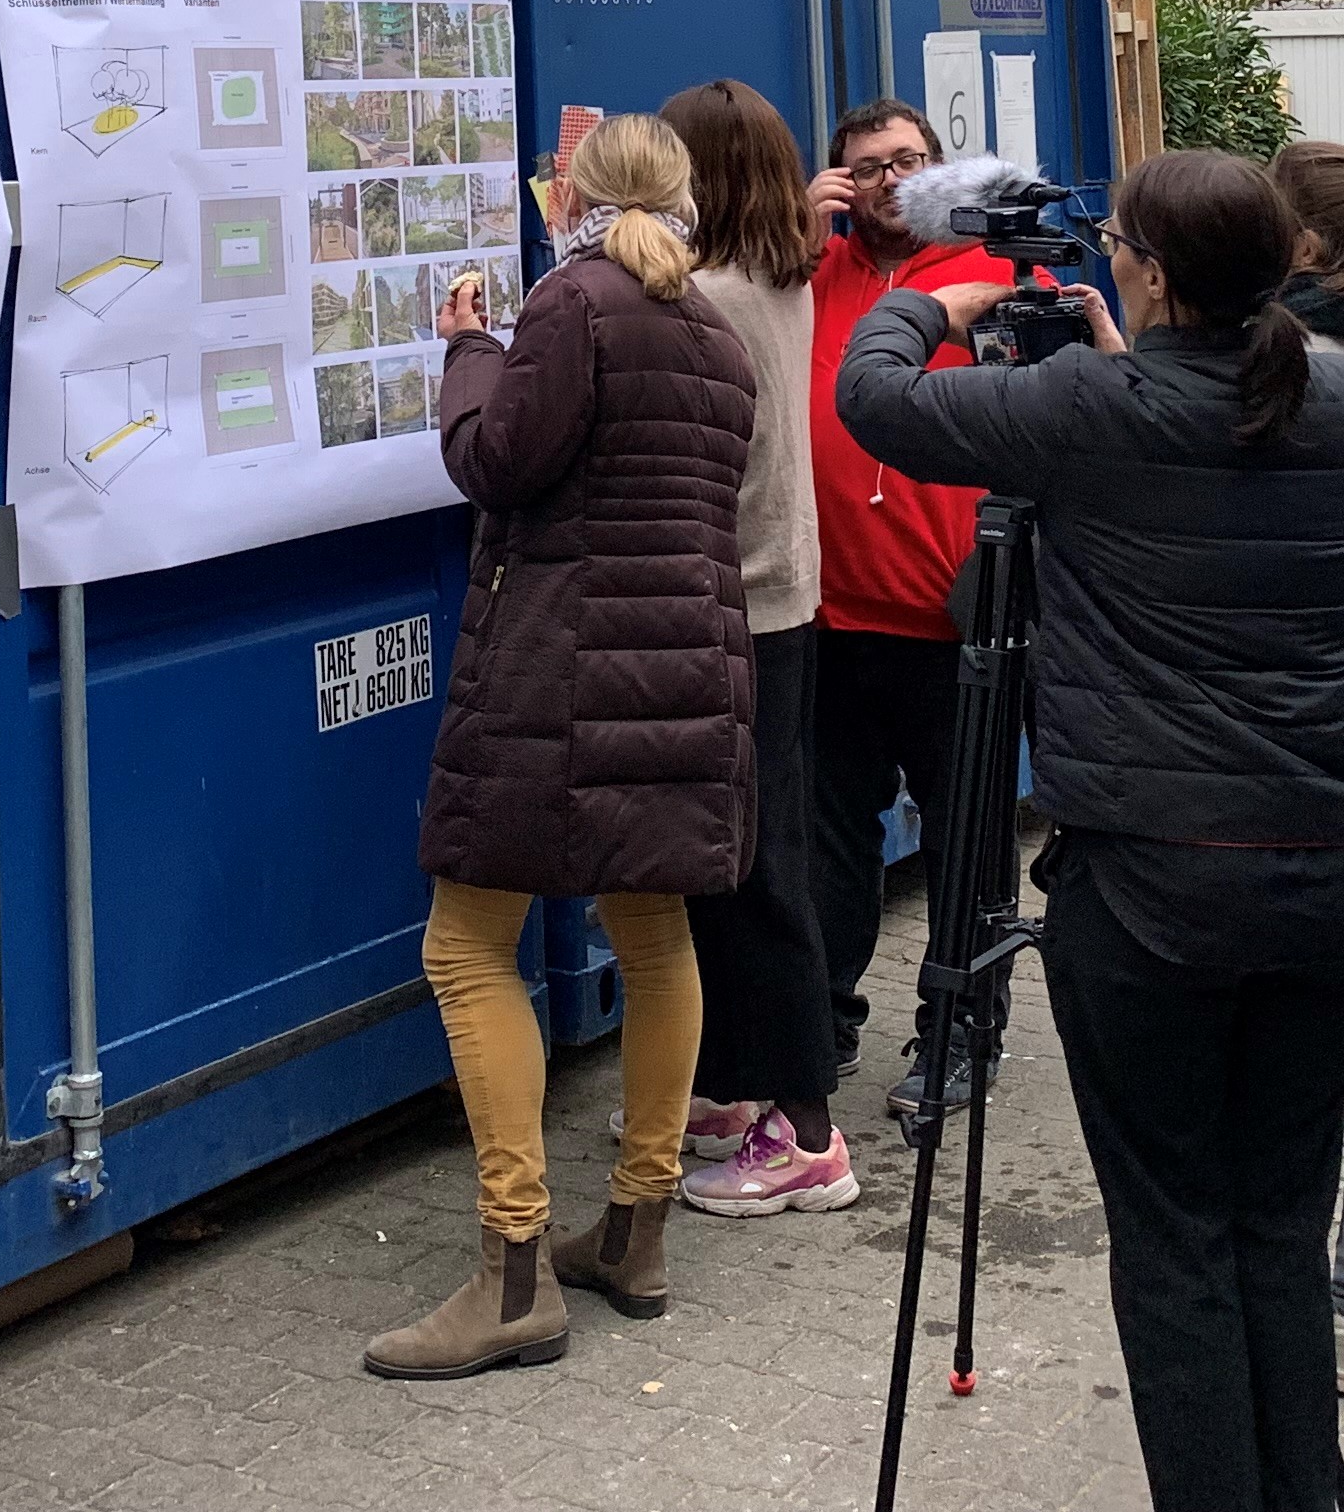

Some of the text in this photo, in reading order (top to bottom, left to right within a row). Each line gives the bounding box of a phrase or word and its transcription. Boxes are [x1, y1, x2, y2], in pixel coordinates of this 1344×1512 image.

[949, 90, 967, 151] 6
[27, 314, 49, 323] Raum
[24, 465, 51, 476] Achse
[317, 616, 430, 684] TARE 825 KG
[320, 658, 431, 729] NET 6500 KG
